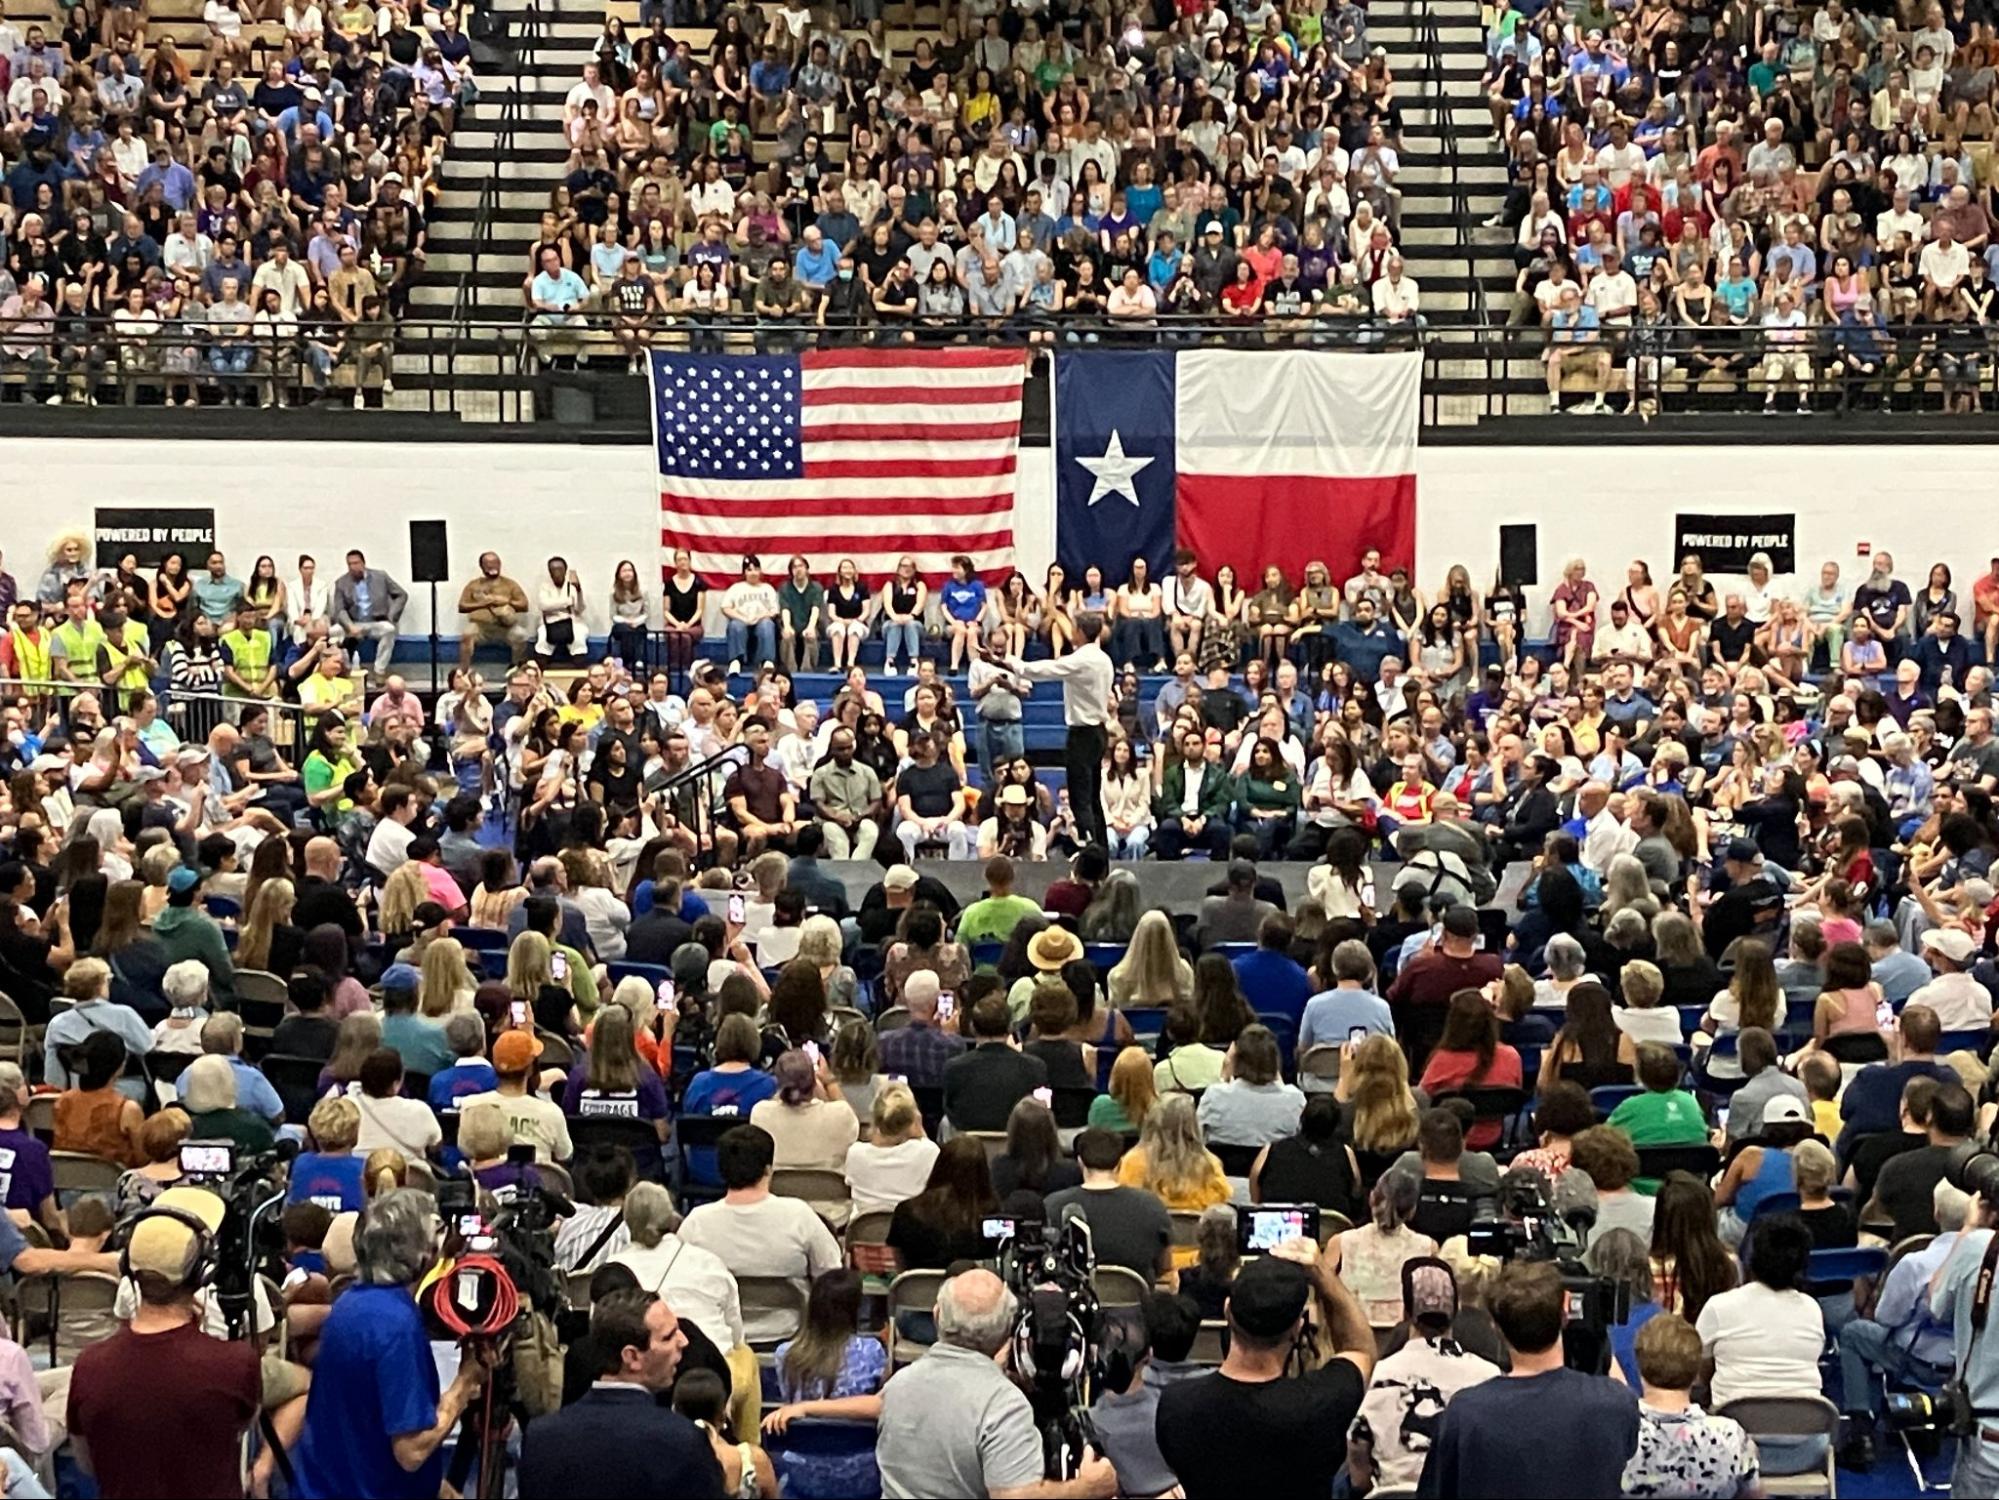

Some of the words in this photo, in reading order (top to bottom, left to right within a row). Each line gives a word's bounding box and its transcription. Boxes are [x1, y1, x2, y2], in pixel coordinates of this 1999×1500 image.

[96, 528, 150, 542] POWERED
[153, 528, 168, 542] BY
[172, 528, 213, 542] PEOPLE
[1682, 533, 1732, 547] POWERED
[1735, 535, 1749, 548] BY
[1751, 533, 1788, 548] PEOPLE
